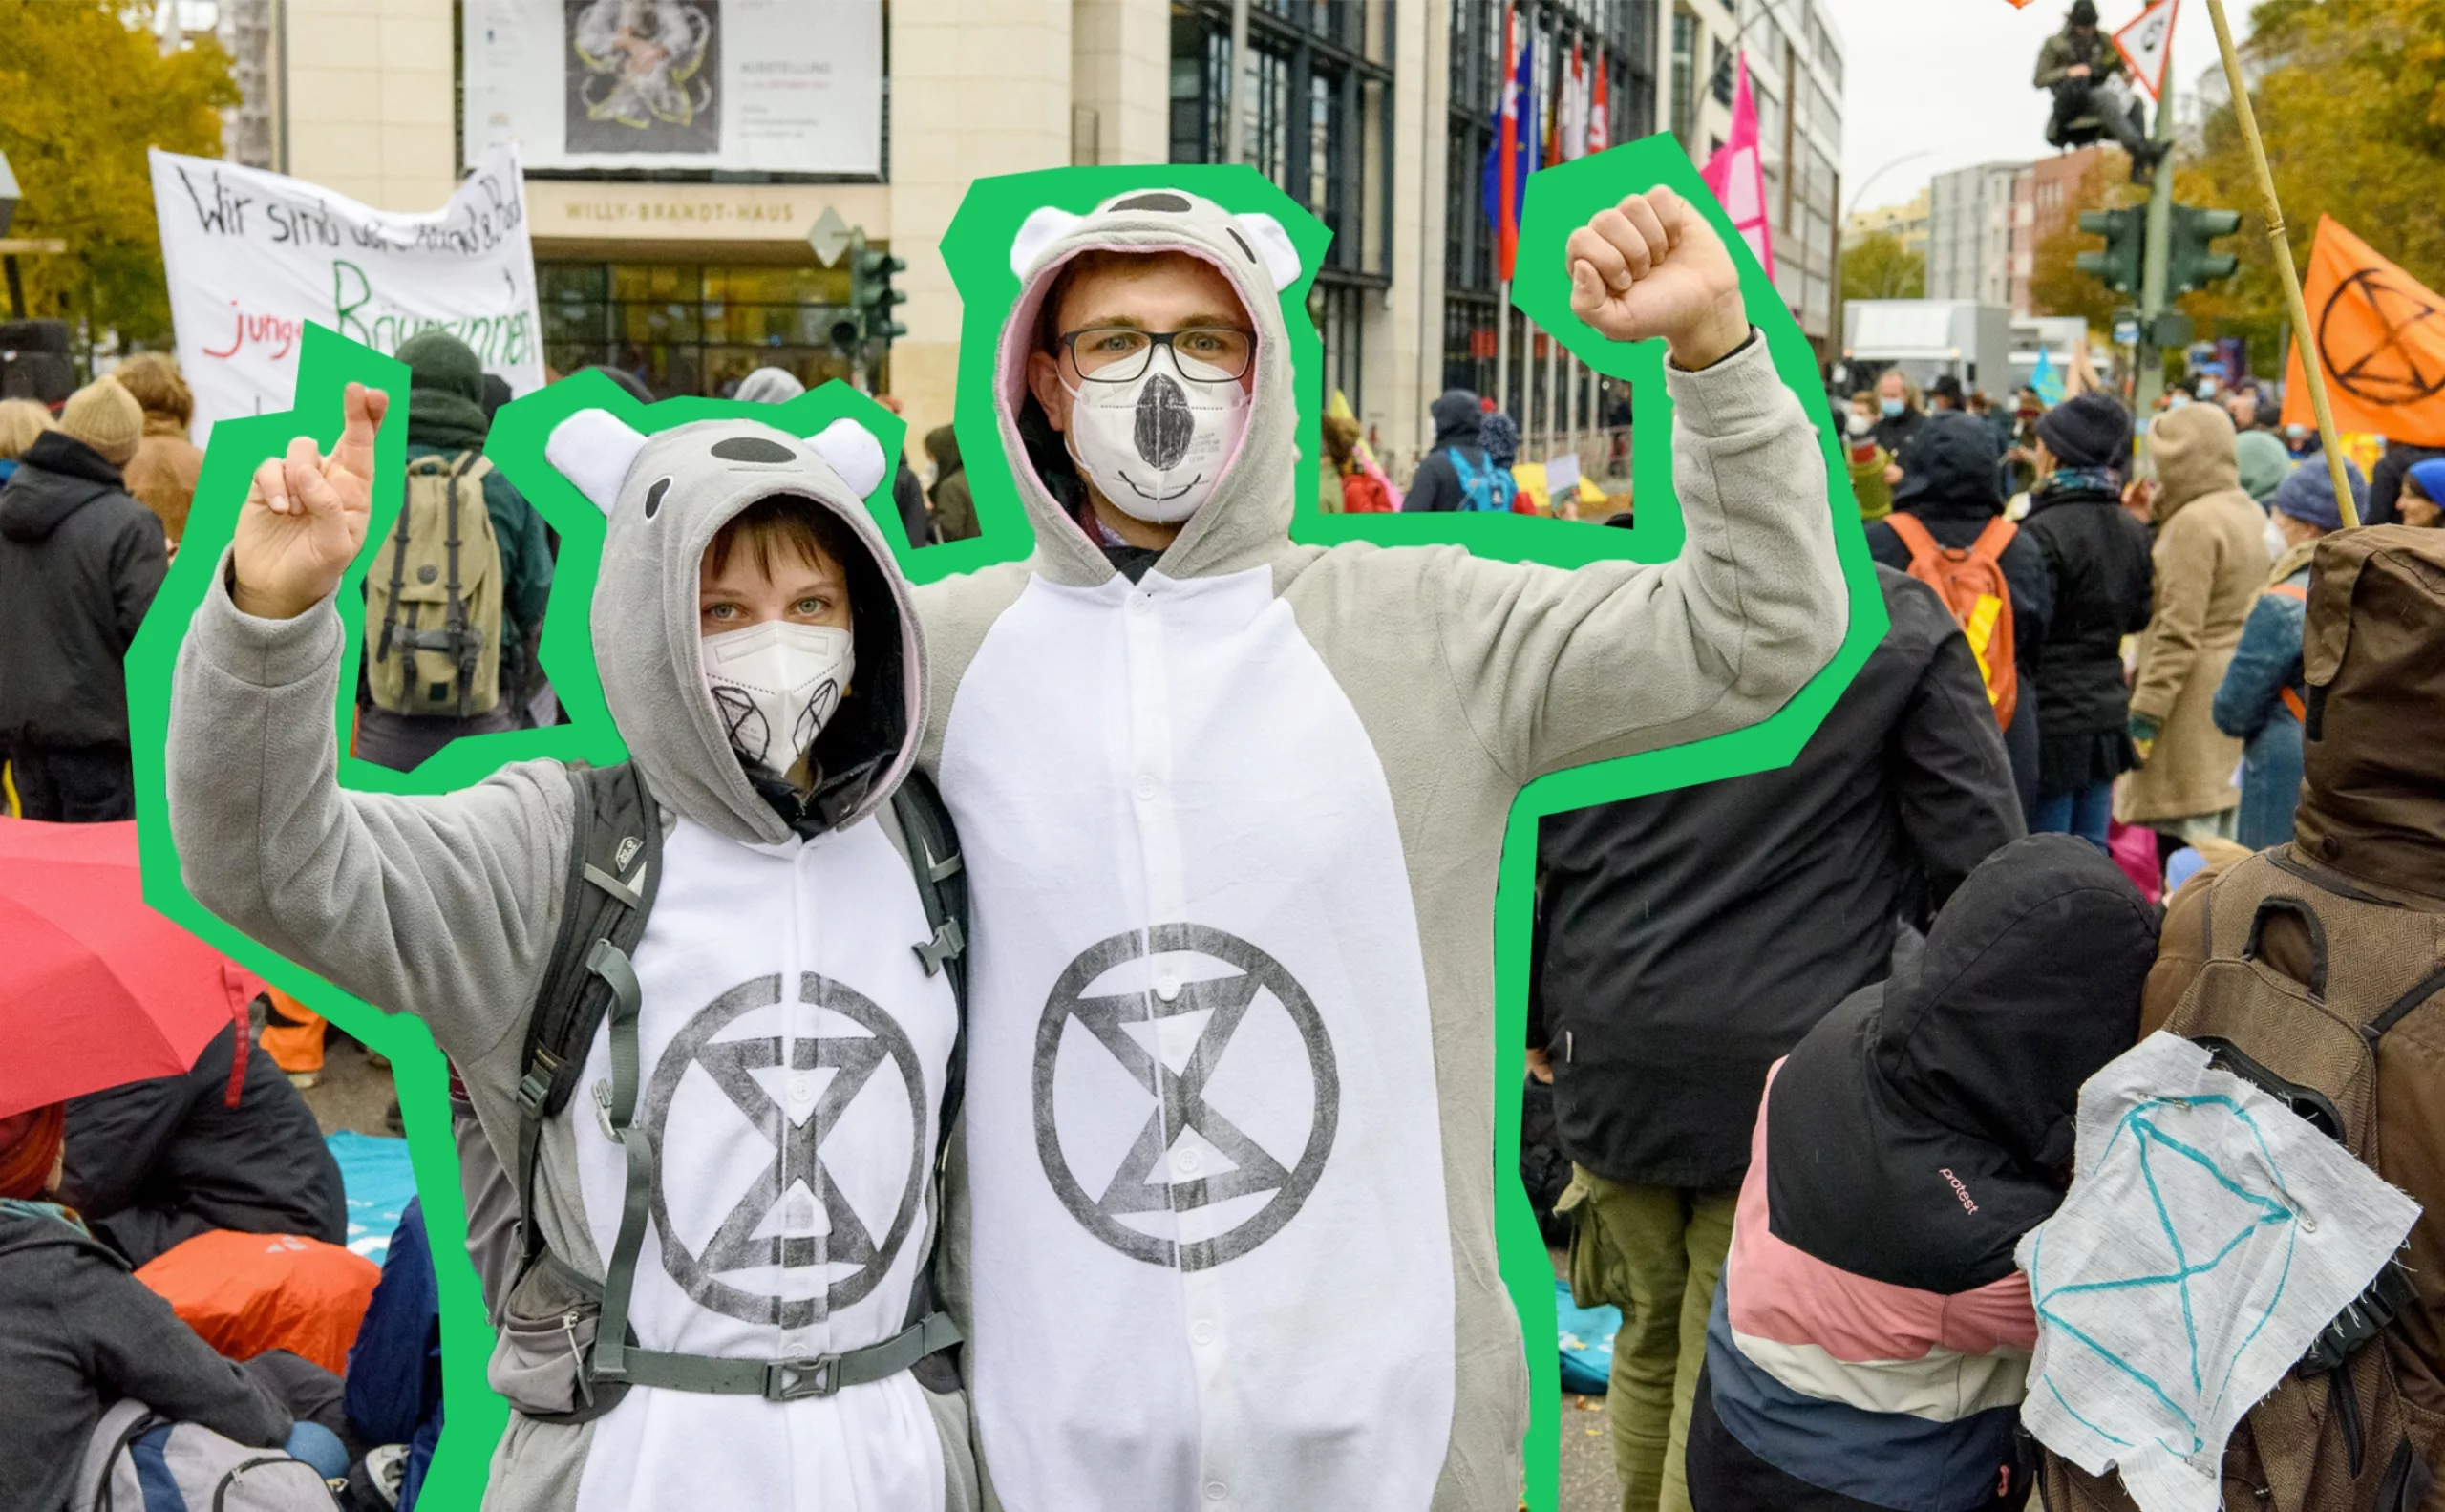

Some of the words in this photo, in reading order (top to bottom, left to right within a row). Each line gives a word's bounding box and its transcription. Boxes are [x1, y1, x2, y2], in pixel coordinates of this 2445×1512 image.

[177, 165, 252, 236] Wir
[266, 199, 340, 247] sind
[564, 202, 795, 222] WILLY-BRANDT-HAUS
[202, 300, 303, 361] jung
[1939, 1168, 1979, 1216] protest
